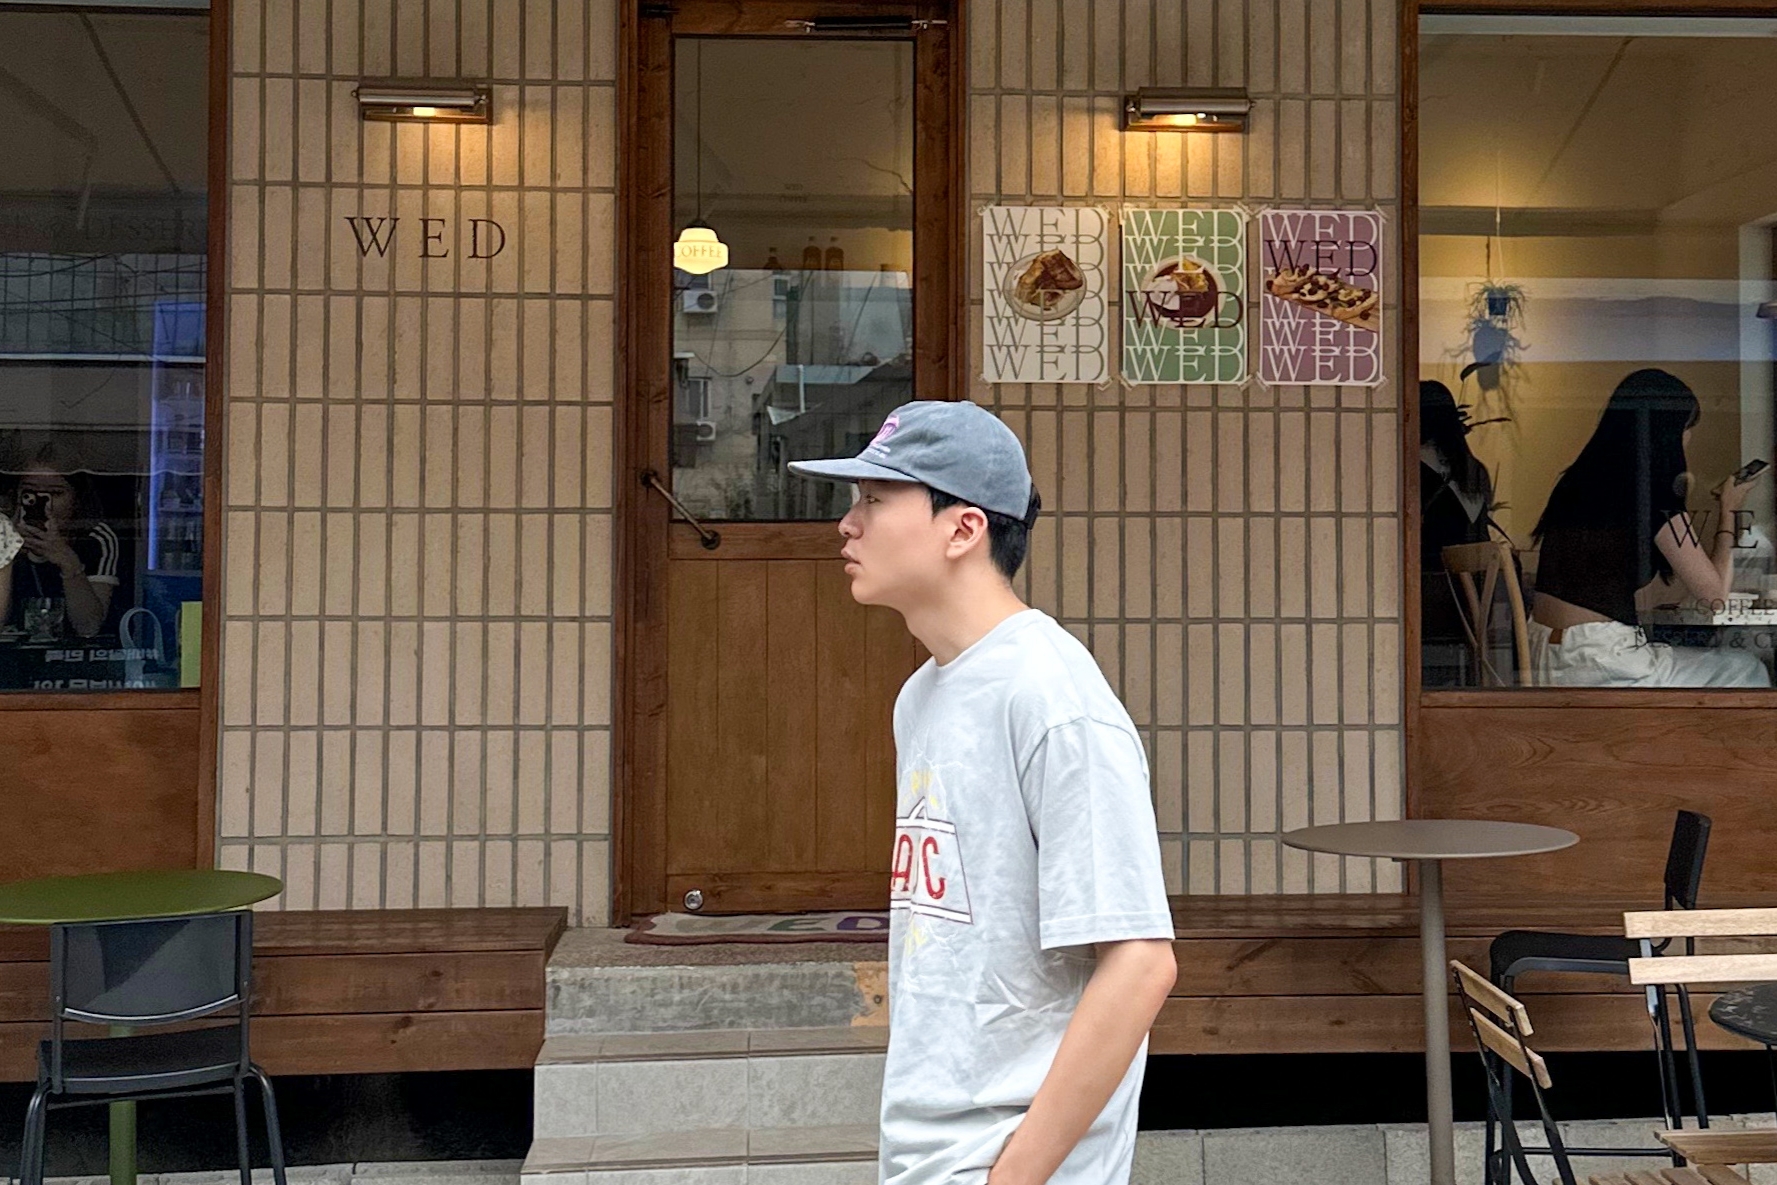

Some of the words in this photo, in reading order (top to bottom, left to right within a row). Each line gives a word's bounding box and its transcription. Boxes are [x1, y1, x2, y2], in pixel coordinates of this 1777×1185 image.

[344, 216, 506, 259] WED
[988, 208, 1105, 243] WED
[1126, 210, 1243, 246] WED
[1264, 214, 1378, 250] WED
[1126, 236, 1243, 273] WED
[1264, 240, 1378, 276] WED
[1126, 291, 1244, 329] WED
[986, 316, 1106, 354] WED
[986, 345, 1106, 381] WED
[1126, 346, 1243, 382] WED
[1263, 346, 1378, 382] WED
[1696, 598, 1774, 616] COFFEE
